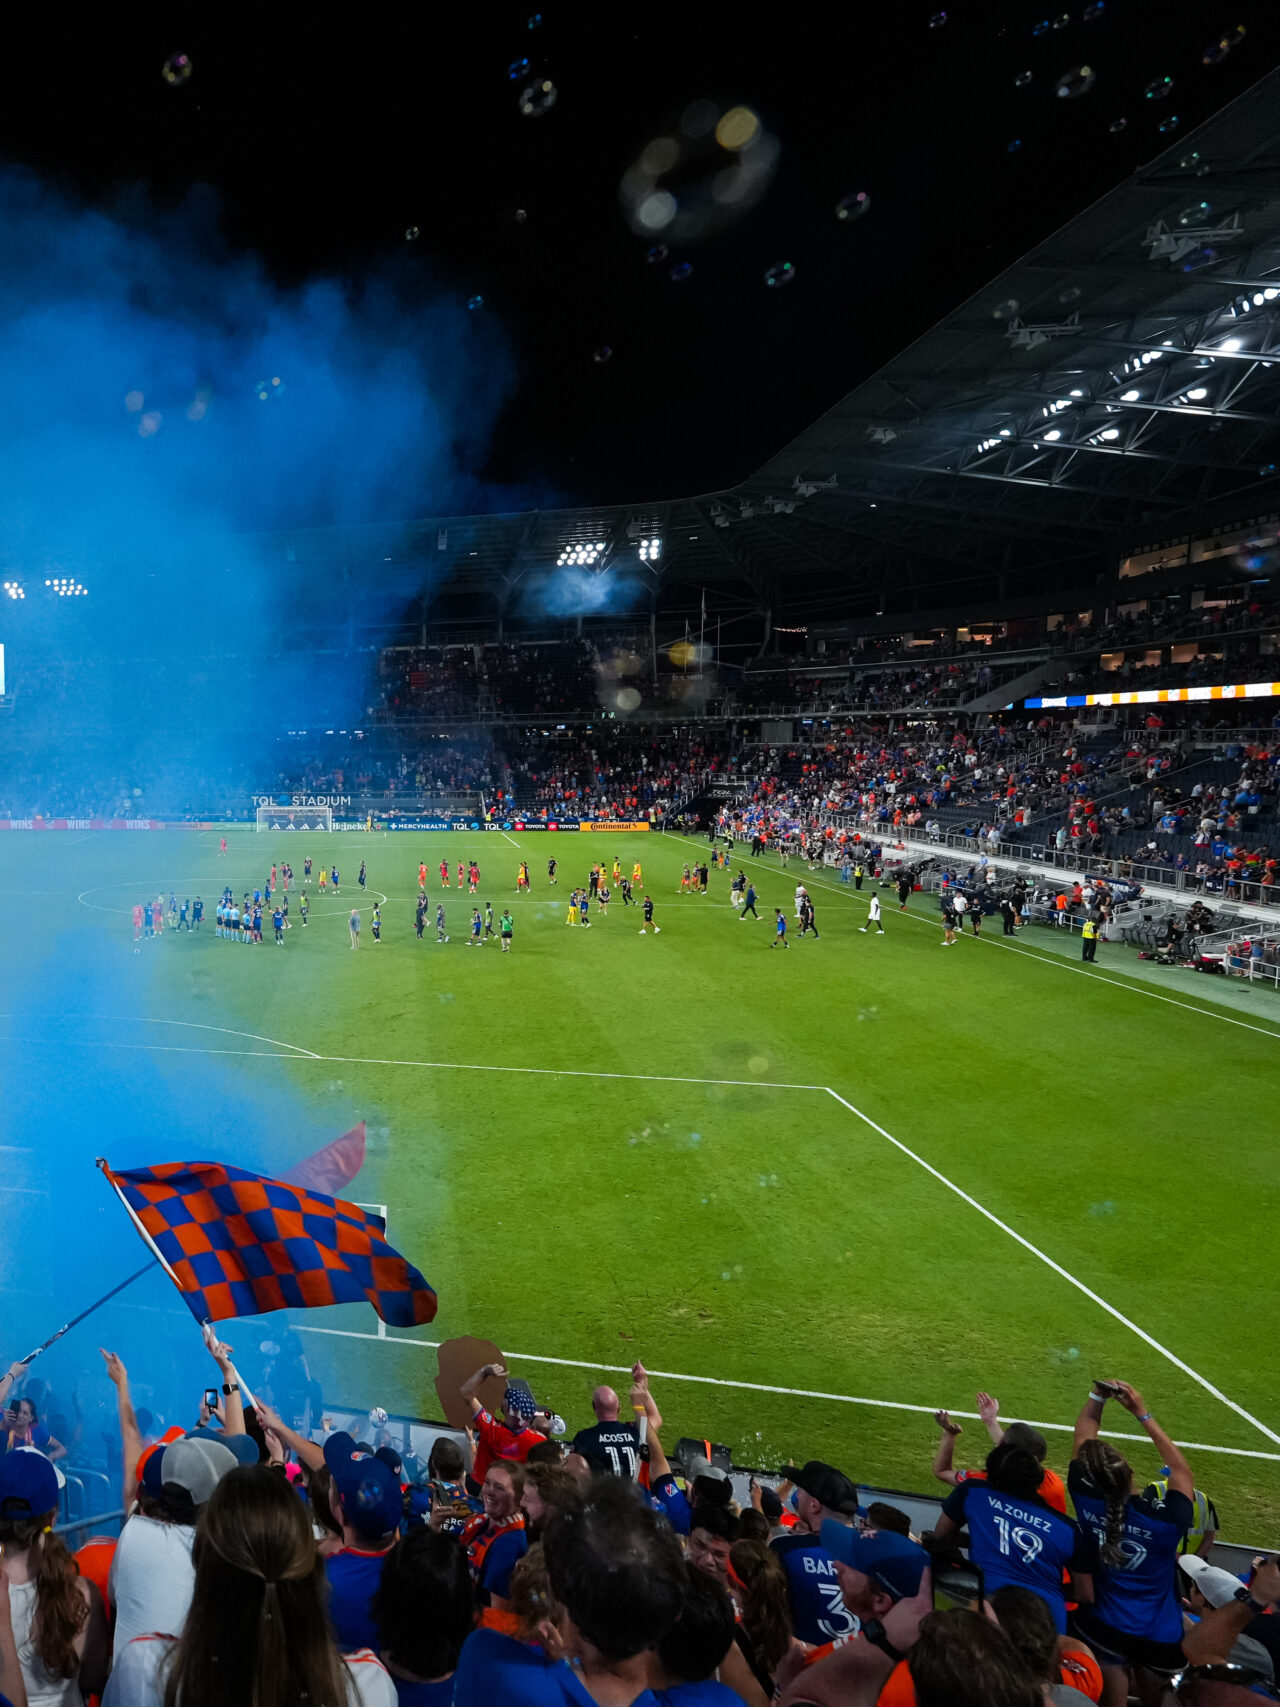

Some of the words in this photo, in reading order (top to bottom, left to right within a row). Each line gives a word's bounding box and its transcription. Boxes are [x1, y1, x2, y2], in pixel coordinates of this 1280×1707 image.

[251, 795, 278, 806] TQL
[291, 795, 352, 806] STADIUM
[10, 819, 34, 831] WINS
[66, 819, 91, 831] WINS
[124, 819, 151, 831] WINS
[332, 822, 368, 831] Heineke
[451, 822, 470, 831] TQL
[483, 822, 503, 831] TQL
[590, 822, 632, 831] Continental
[598, 1432, 635, 1443] ACOSTA
[604, 1446, 636, 1477] 11
[987, 1495, 1053, 1533] VAZQUEZ
[993, 1515, 1044, 1564] 19
